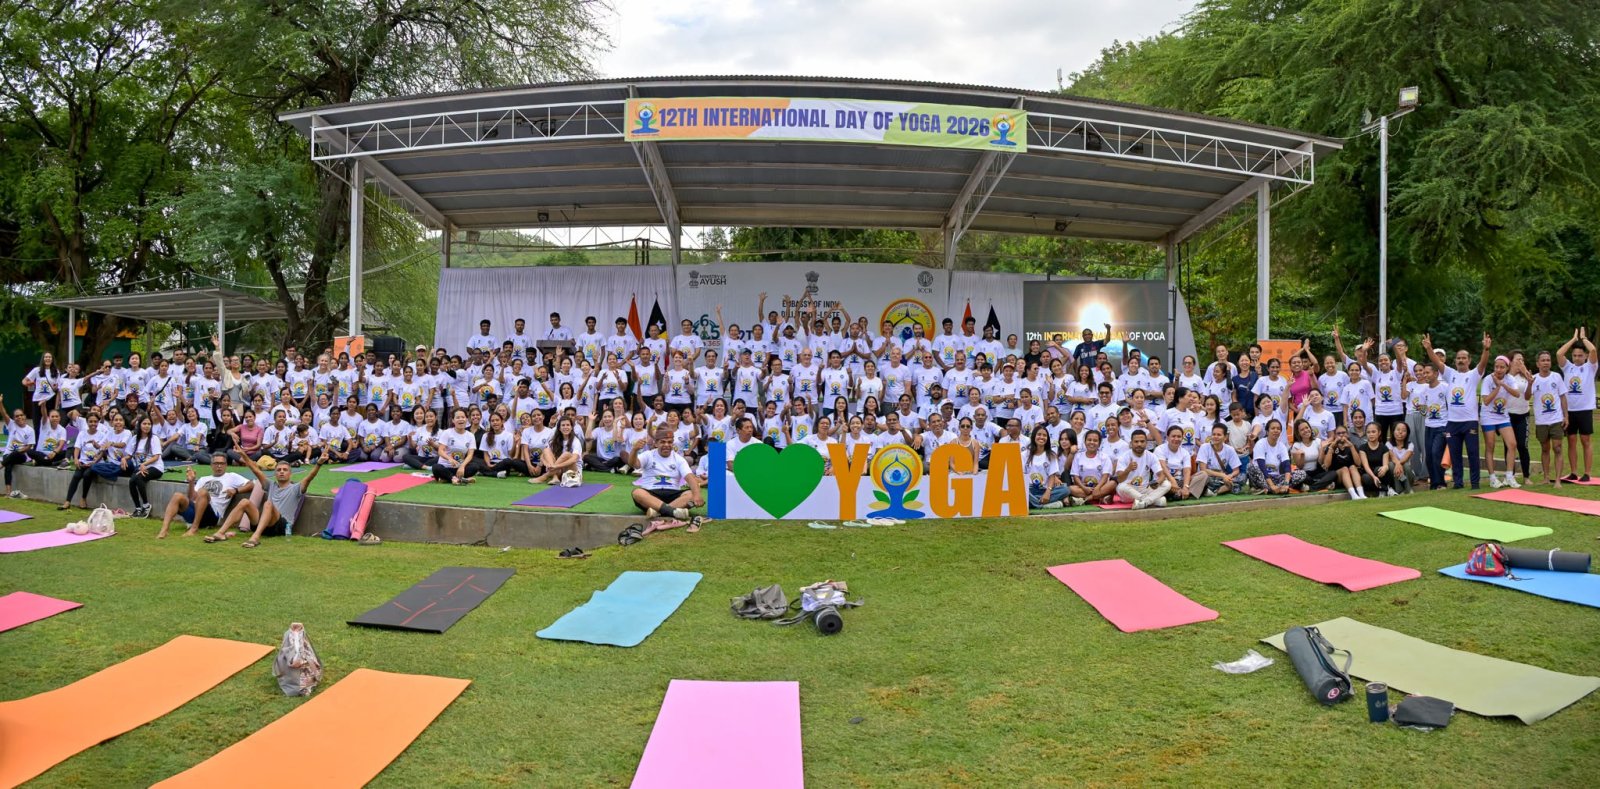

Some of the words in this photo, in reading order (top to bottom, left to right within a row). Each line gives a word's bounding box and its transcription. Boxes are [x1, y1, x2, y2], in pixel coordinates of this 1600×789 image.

[659, 108, 698, 127] 12TH
[703, 107, 829, 128] INTERNATIONAL
[835, 109, 868, 130] DAY
[873, 111, 893, 131] OF
[898, 112, 941, 133] YOGA
[946, 116, 990, 137] 2026
[700, 278, 727, 286] AYUSH
[1026, 332, 1042, 340] 12th
[1129, 331, 1140, 340] OF
[1142, 332, 1165, 340] YOGA
[707, 442, 727, 519] I
